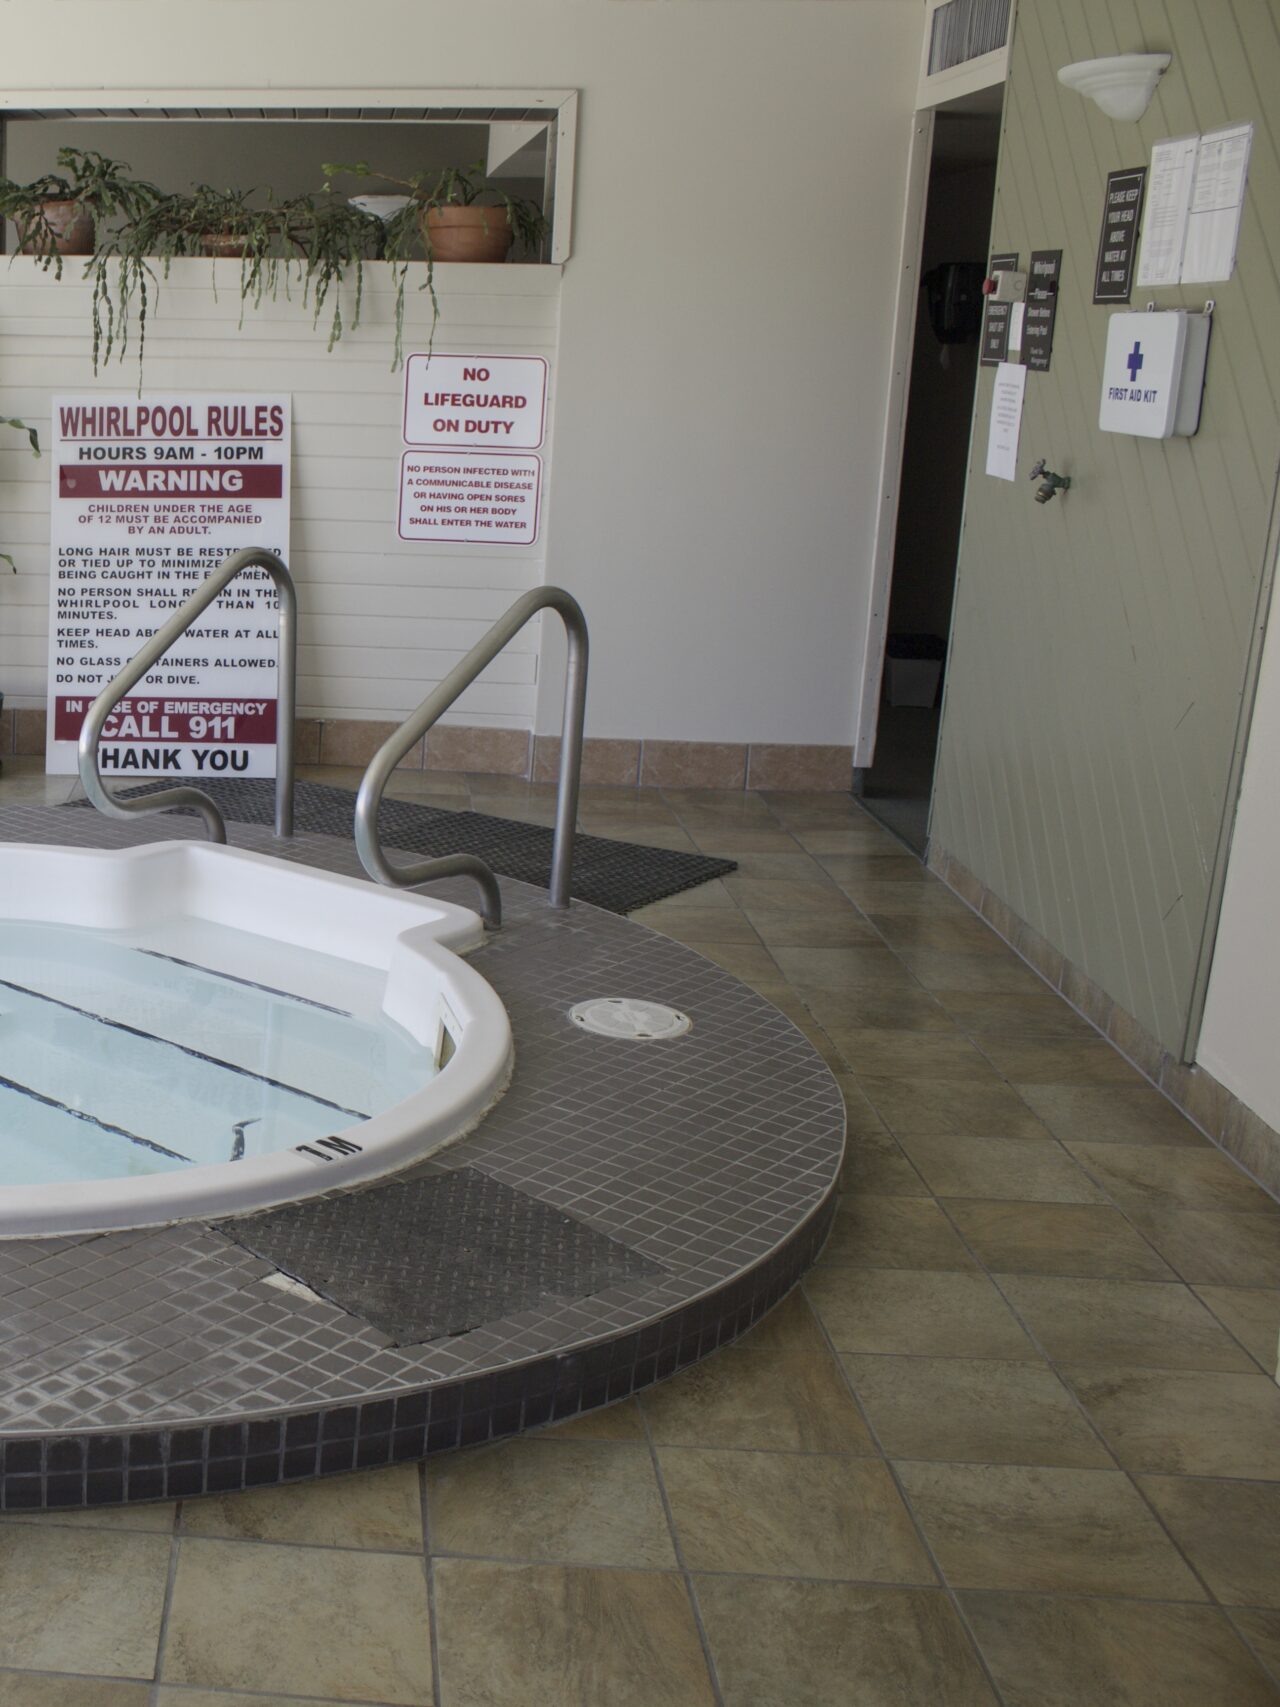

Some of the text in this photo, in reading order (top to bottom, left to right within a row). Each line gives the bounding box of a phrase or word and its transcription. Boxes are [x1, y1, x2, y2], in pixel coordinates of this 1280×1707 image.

[1108, 189, 1138, 203] PLEASE KEEP
[1120, 210, 1134, 222] HEAD
[1109, 230, 1126, 242] ABOVE
[1104, 250, 1128, 262] WATER AT
[1101, 270, 1126, 282] ALL TIMES
[463, 368, 490, 381] NO
[424, 392, 526, 408] LIFEGUARD
[1108, 388, 1157, 402] FIRST AID KIT
[60, 406, 283, 437] WHIRLPOOL RULES
[432, 419, 514, 434] ON DUTY
[79, 447, 147, 460] HOURS
[154, 447, 194, 460] 9AM
[214, 447, 264, 460] 10PM
[422, 466, 460, 474] PERSON
[463, 468, 508, 476] INFECTED
[99, 470, 243, 492] WARNING
[416, 479, 492, 488] COMMUNICABLE
[429, 492, 464, 500] HAVING
[466, 494, 492, 502] OPEN
[88, 504, 252, 513] CHILDREN UNDER THE AGE
[470, 506, 489, 514] HER
[78, 516, 262, 524] OF 12 MUST BE ACCOMPANIED
[495, 520, 526, 528] WATER
[128, 526, 212, 534] BY AN ADULT.
[58, 548, 94, 556] LONG
[99, 548, 130, 556] HAIR
[136, 548, 171, 556] MUST
[177, 548, 193, 556] BE
[58, 560, 222, 568] OR TIED UP TO MINIMIZE
[58, 571, 270, 580] BEING CAUGHT IN THE EPMEN
[58, 588, 75, 597] NO
[81, 588, 131, 597] PERSON
[137, 588, 177, 597] SHALL
[238, 588, 250, 597] IN
[256, 588, 279, 597] THE
[58, 600, 140, 609] WHIRLPOOL
[217, 600, 254, 609] THAN
[266, 601, 279, 609] 10
[58, 611, 117, 620] MINUTES.
[57, 628, 90, 636] KEEP
[96, 629, 130, 637] HEAD
[185, 630, 229, 638] WATER
[235, 630, 250, 638] AT
[256, 630, 279, 638] ALL
[57, 640, 98, 648] TIMES.
[56, 657, 74, 665] NO
[80, 657, 121, 666] GLASS
[214, 659, 279, 668] ALLOWED.
[56, 674, 73, 683] DO
[78, 675, 103, 683] NOT
[146, 675, 200, 684] OR DIVE.
[66, 700, 82, 713] IN
[136, 700, 159, 713] OF
[164, 701, 268, 715] EMERGENCY
[100, 715, 235, 739] CALL 911
[97, 748, 249, 770] HANK YOU
